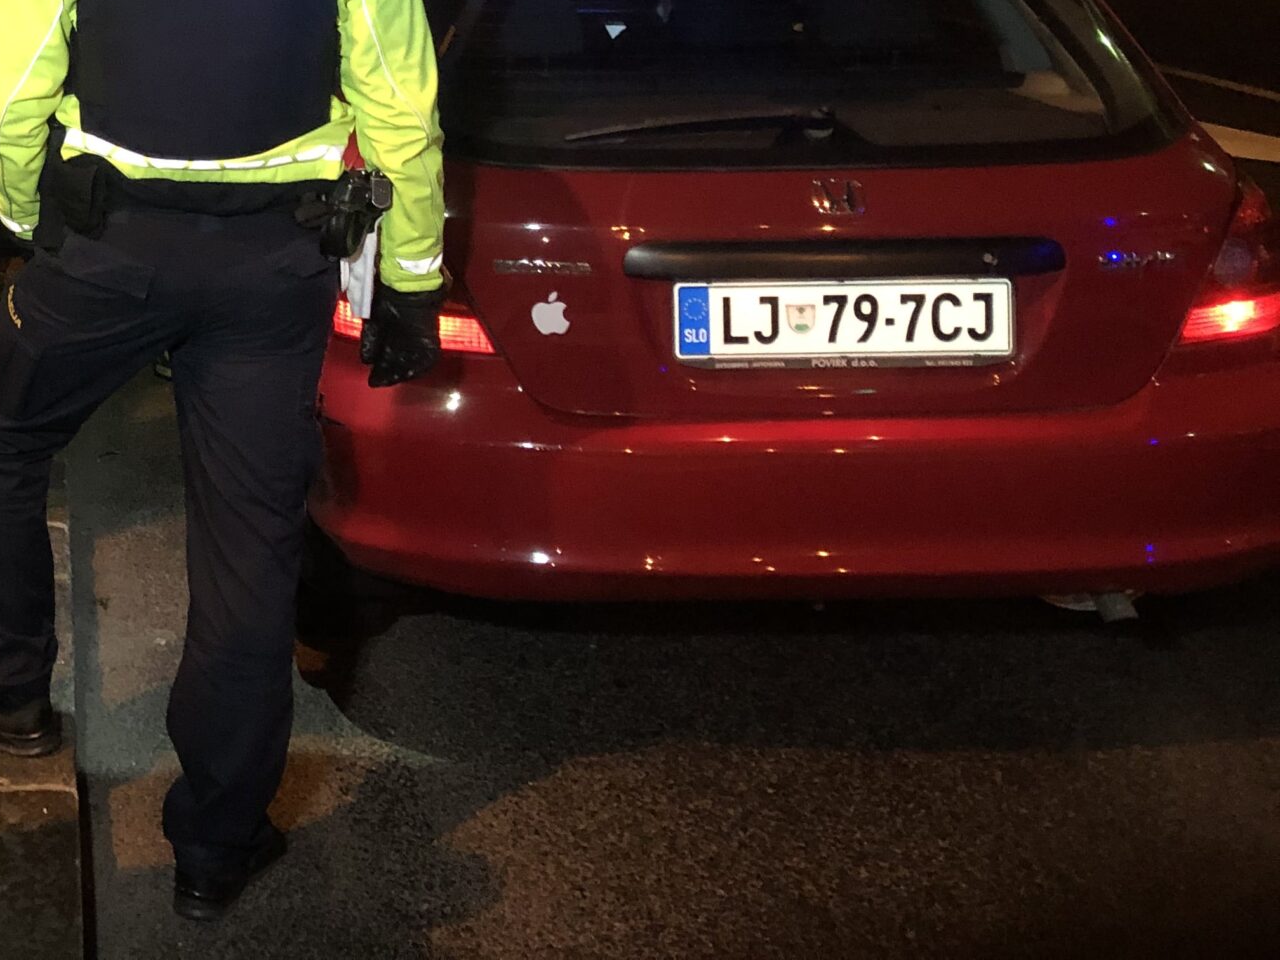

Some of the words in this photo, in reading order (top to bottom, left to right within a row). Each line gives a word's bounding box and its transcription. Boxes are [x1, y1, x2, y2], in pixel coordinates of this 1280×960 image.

[683, 327, 708, 343] SLO
[723, 296, 779, 344] LJ
[823, 292, 993, 343] 79-7CJ
